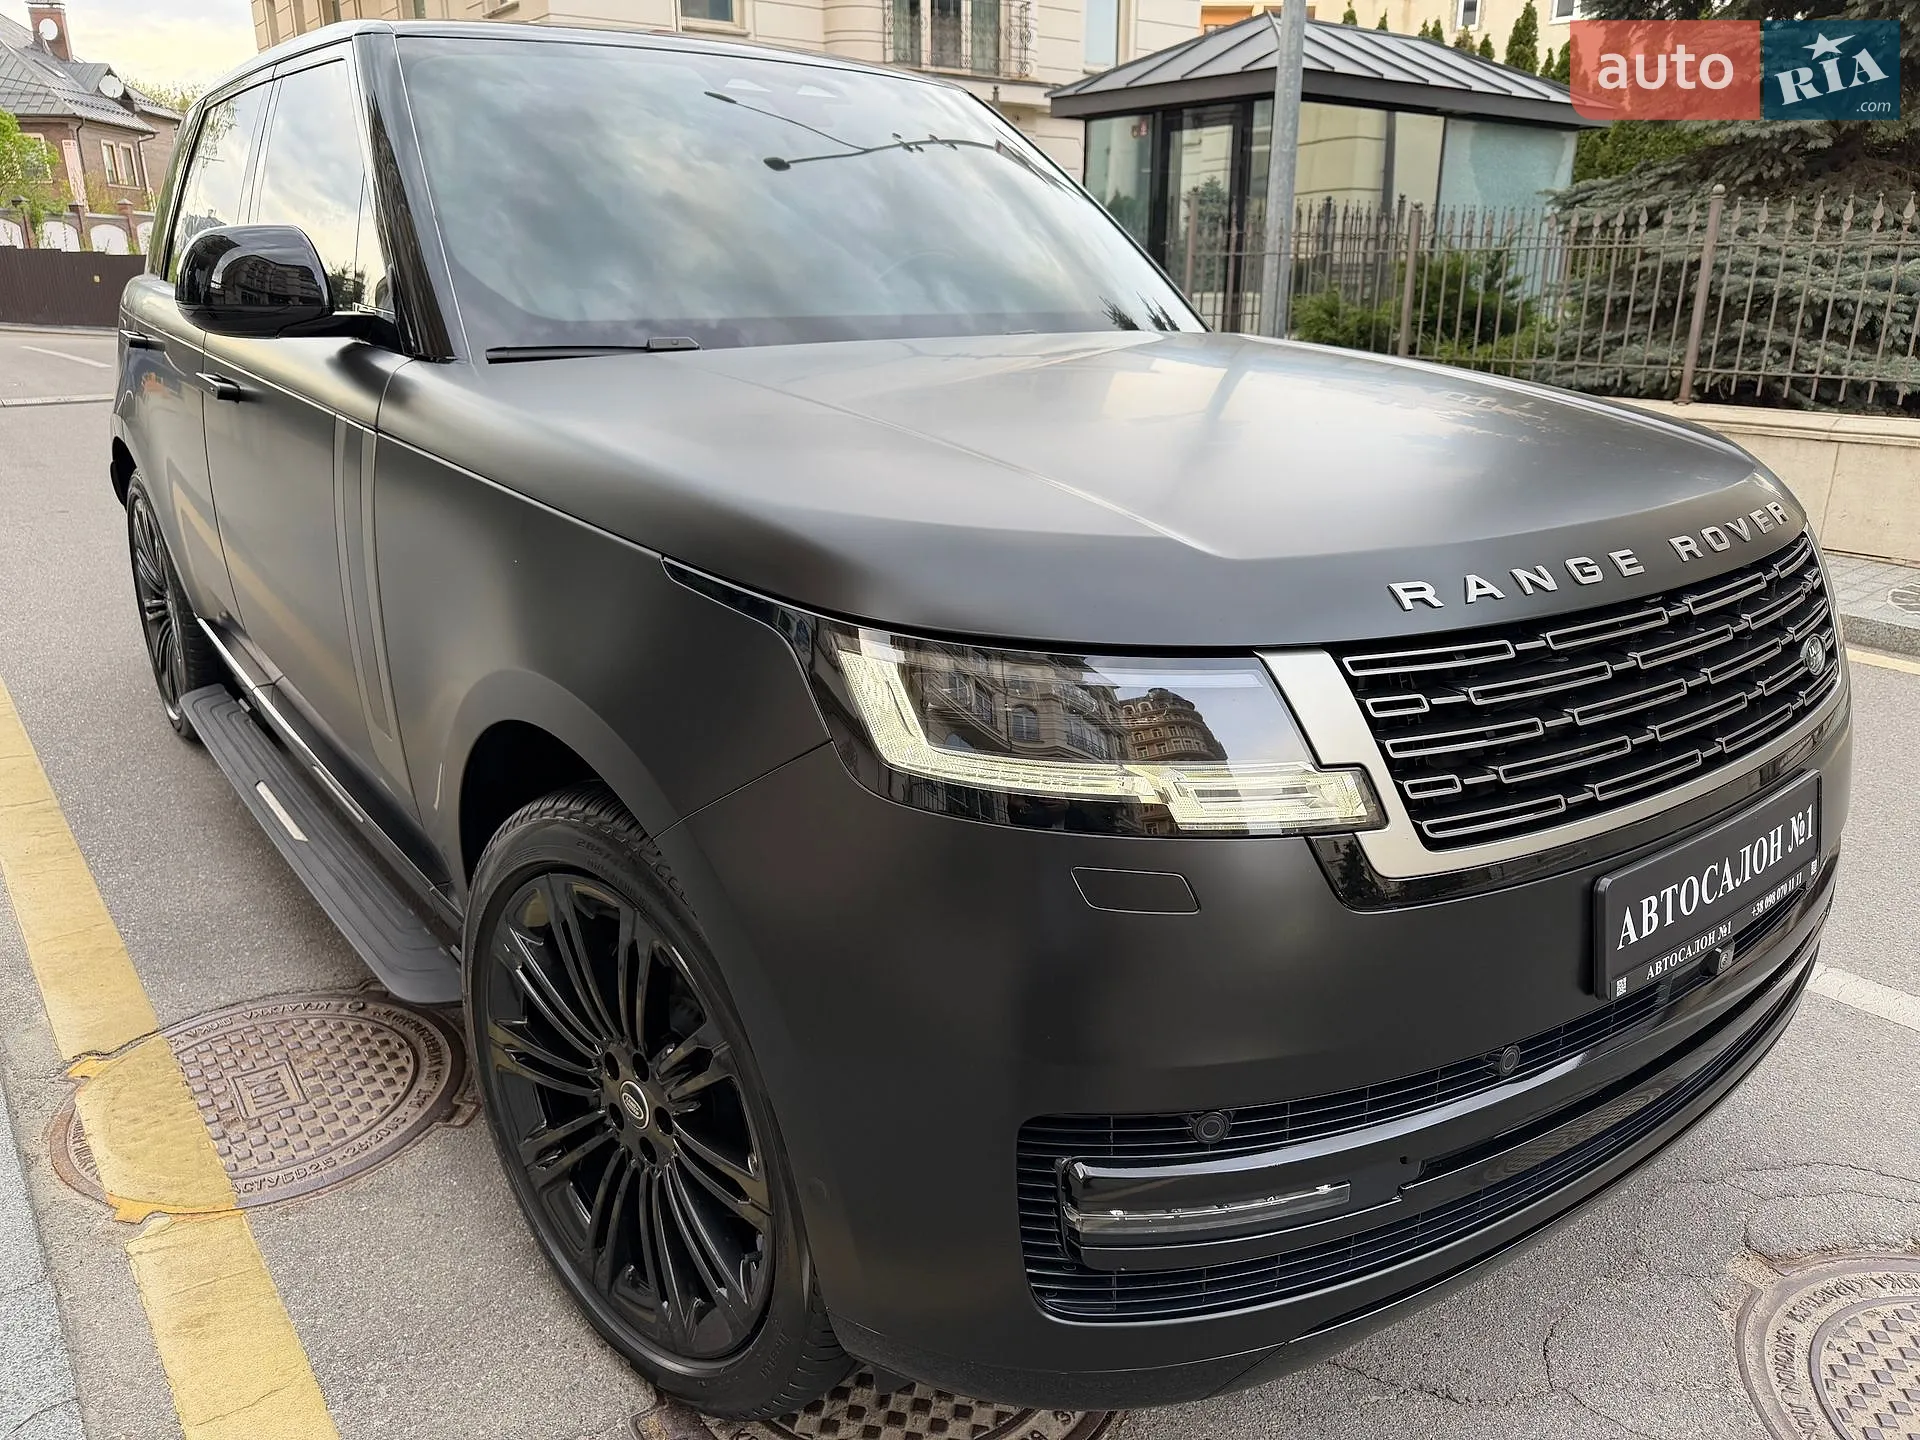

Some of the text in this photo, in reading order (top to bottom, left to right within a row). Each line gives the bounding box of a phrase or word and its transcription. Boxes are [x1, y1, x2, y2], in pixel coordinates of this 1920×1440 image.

[1387, 500, 1790, 612] RANGE ROVER
[1616, 804, 1814, 951] АВТОСАЛОН №1
[1646, 930, 1716, 980] АВТОСАЛОН
